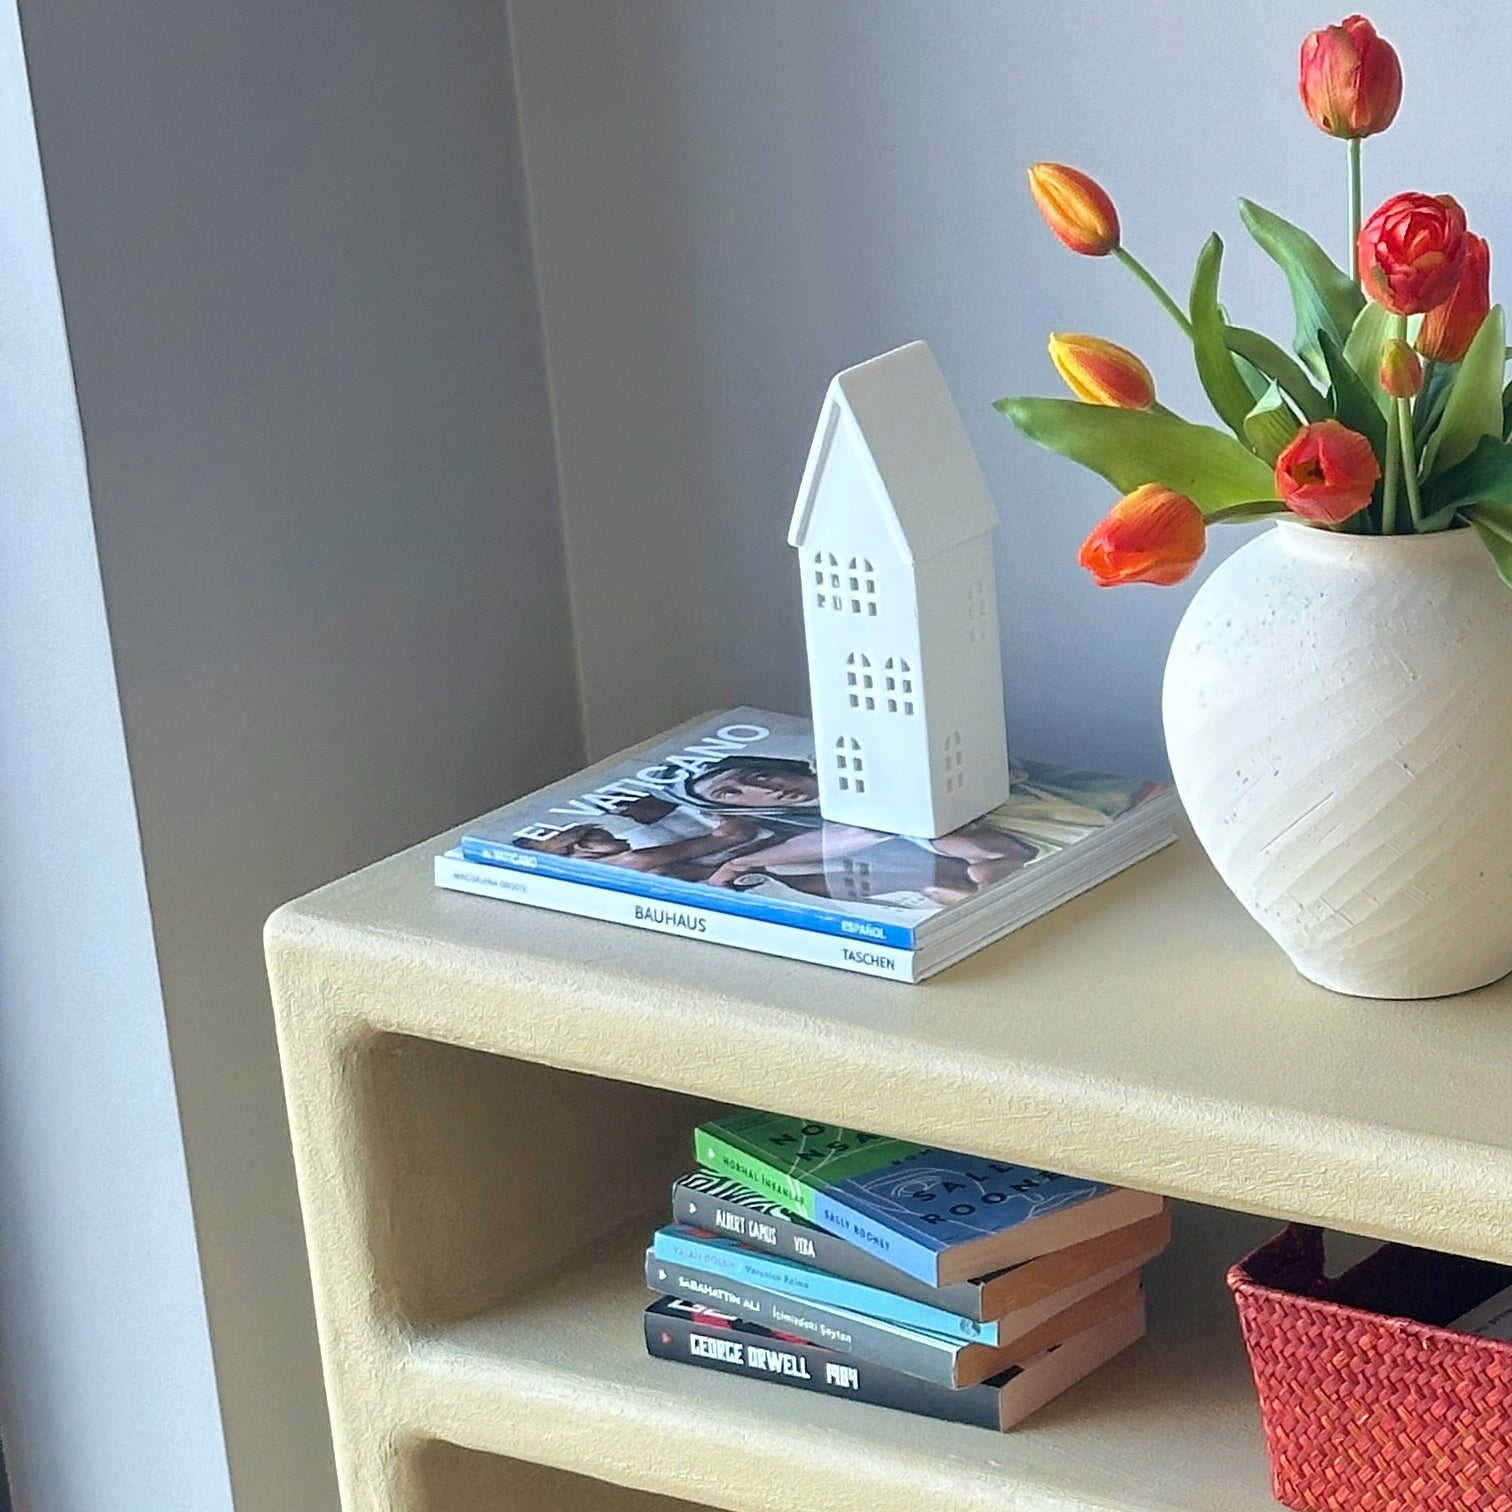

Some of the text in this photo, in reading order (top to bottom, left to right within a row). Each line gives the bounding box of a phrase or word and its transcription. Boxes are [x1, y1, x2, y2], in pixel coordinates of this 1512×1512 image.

[513, 724, 771, 842] EL VATICANO
[634, 904, 708, 933] BAUHAUS
[841, 918, 888, 940] ESPAÑOL
[841, 948, 896, 971] TASCHEN
[912, 1162, 1014, 1202] SALL
[920, 1170, 1066, 1225] ROONE
[715, 1208, 745, 1236] ALBERT
[748, 1218, 778, 1247] CAMUS
[824, 1208, 891, 1252] SALLY ROONEY
[688, 1332, 860, 1391] GEORGE ORWELL 1984
